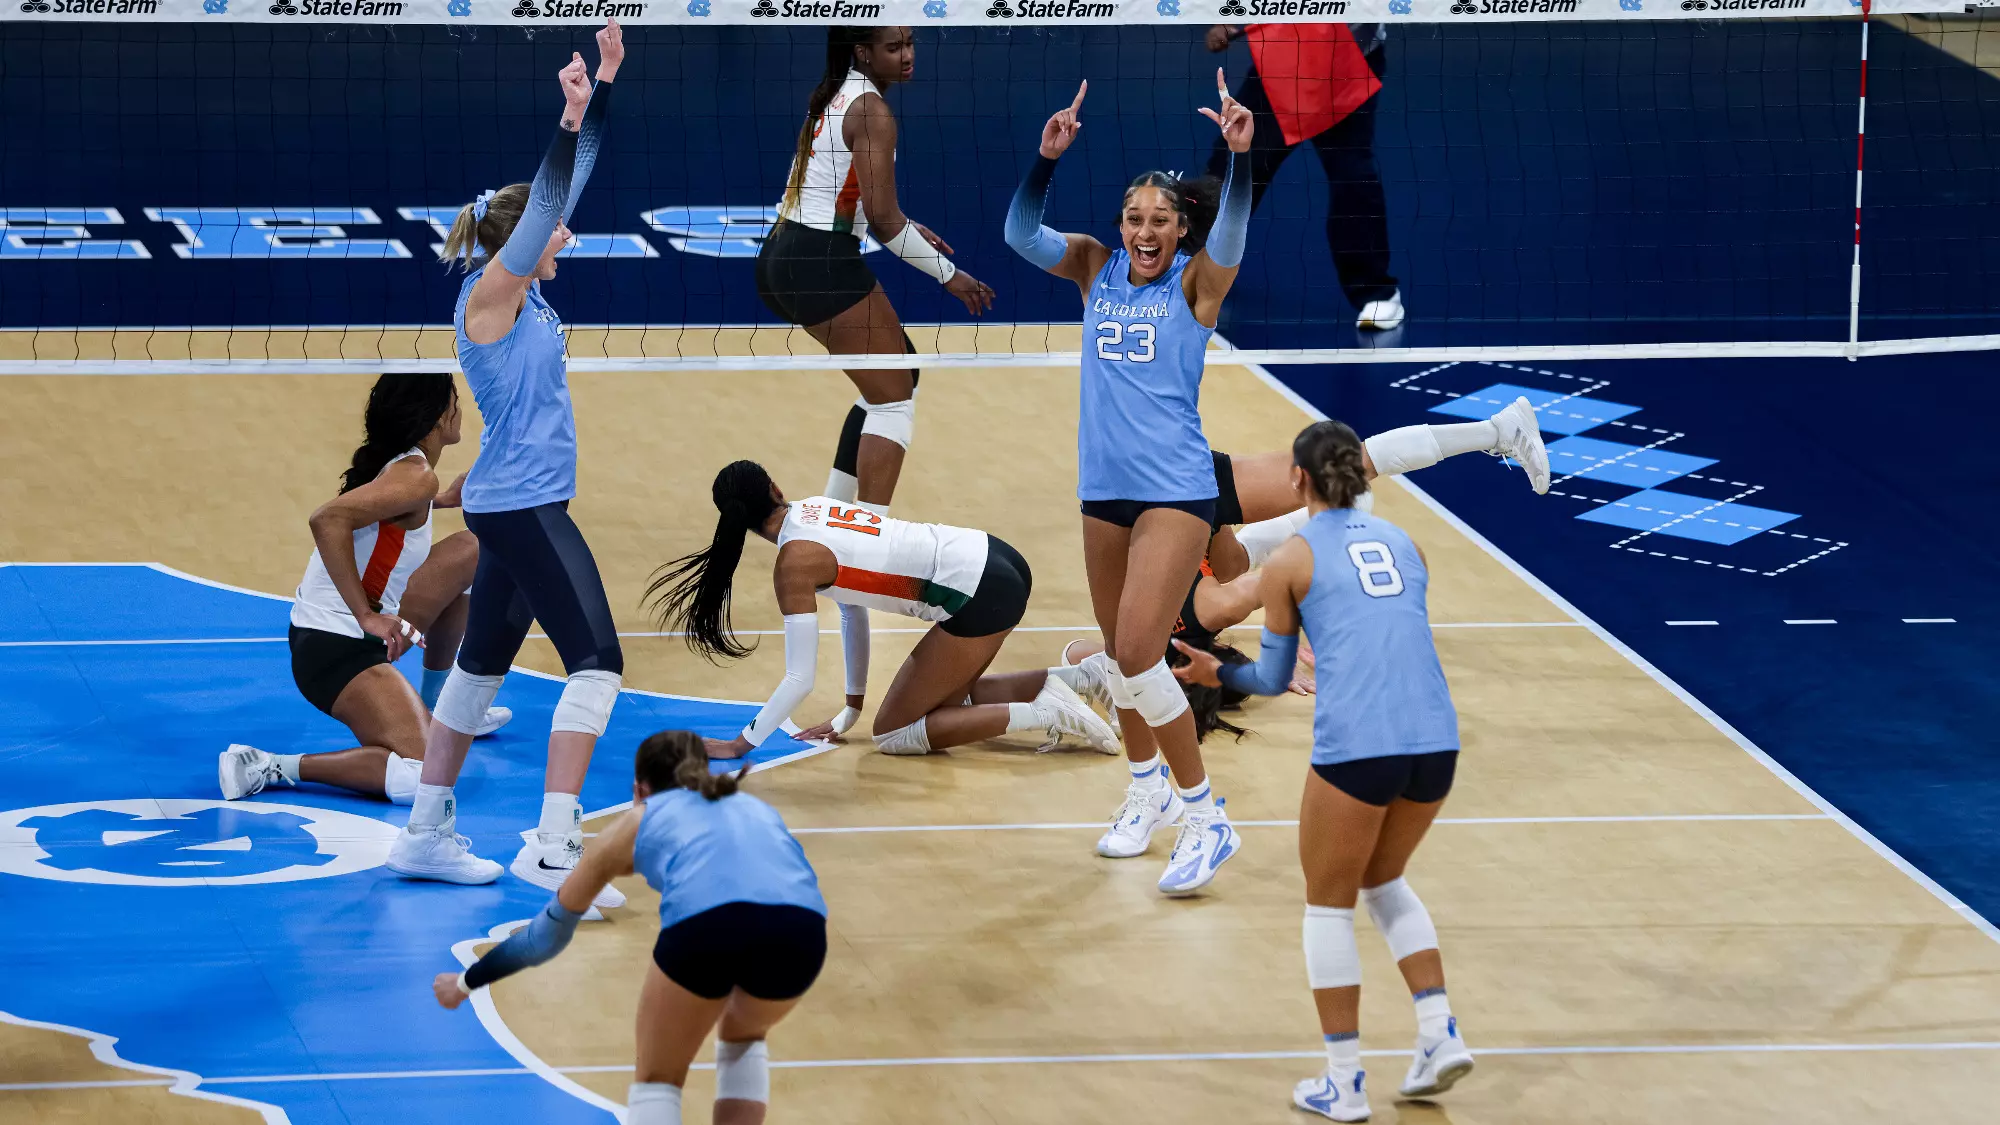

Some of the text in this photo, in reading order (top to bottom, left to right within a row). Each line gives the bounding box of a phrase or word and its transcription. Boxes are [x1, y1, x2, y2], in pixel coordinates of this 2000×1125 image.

[1096, 320, 1157, 363] 23
[826, 506, 882, 537] 15
[1345, 540, 1406, 599] 8
